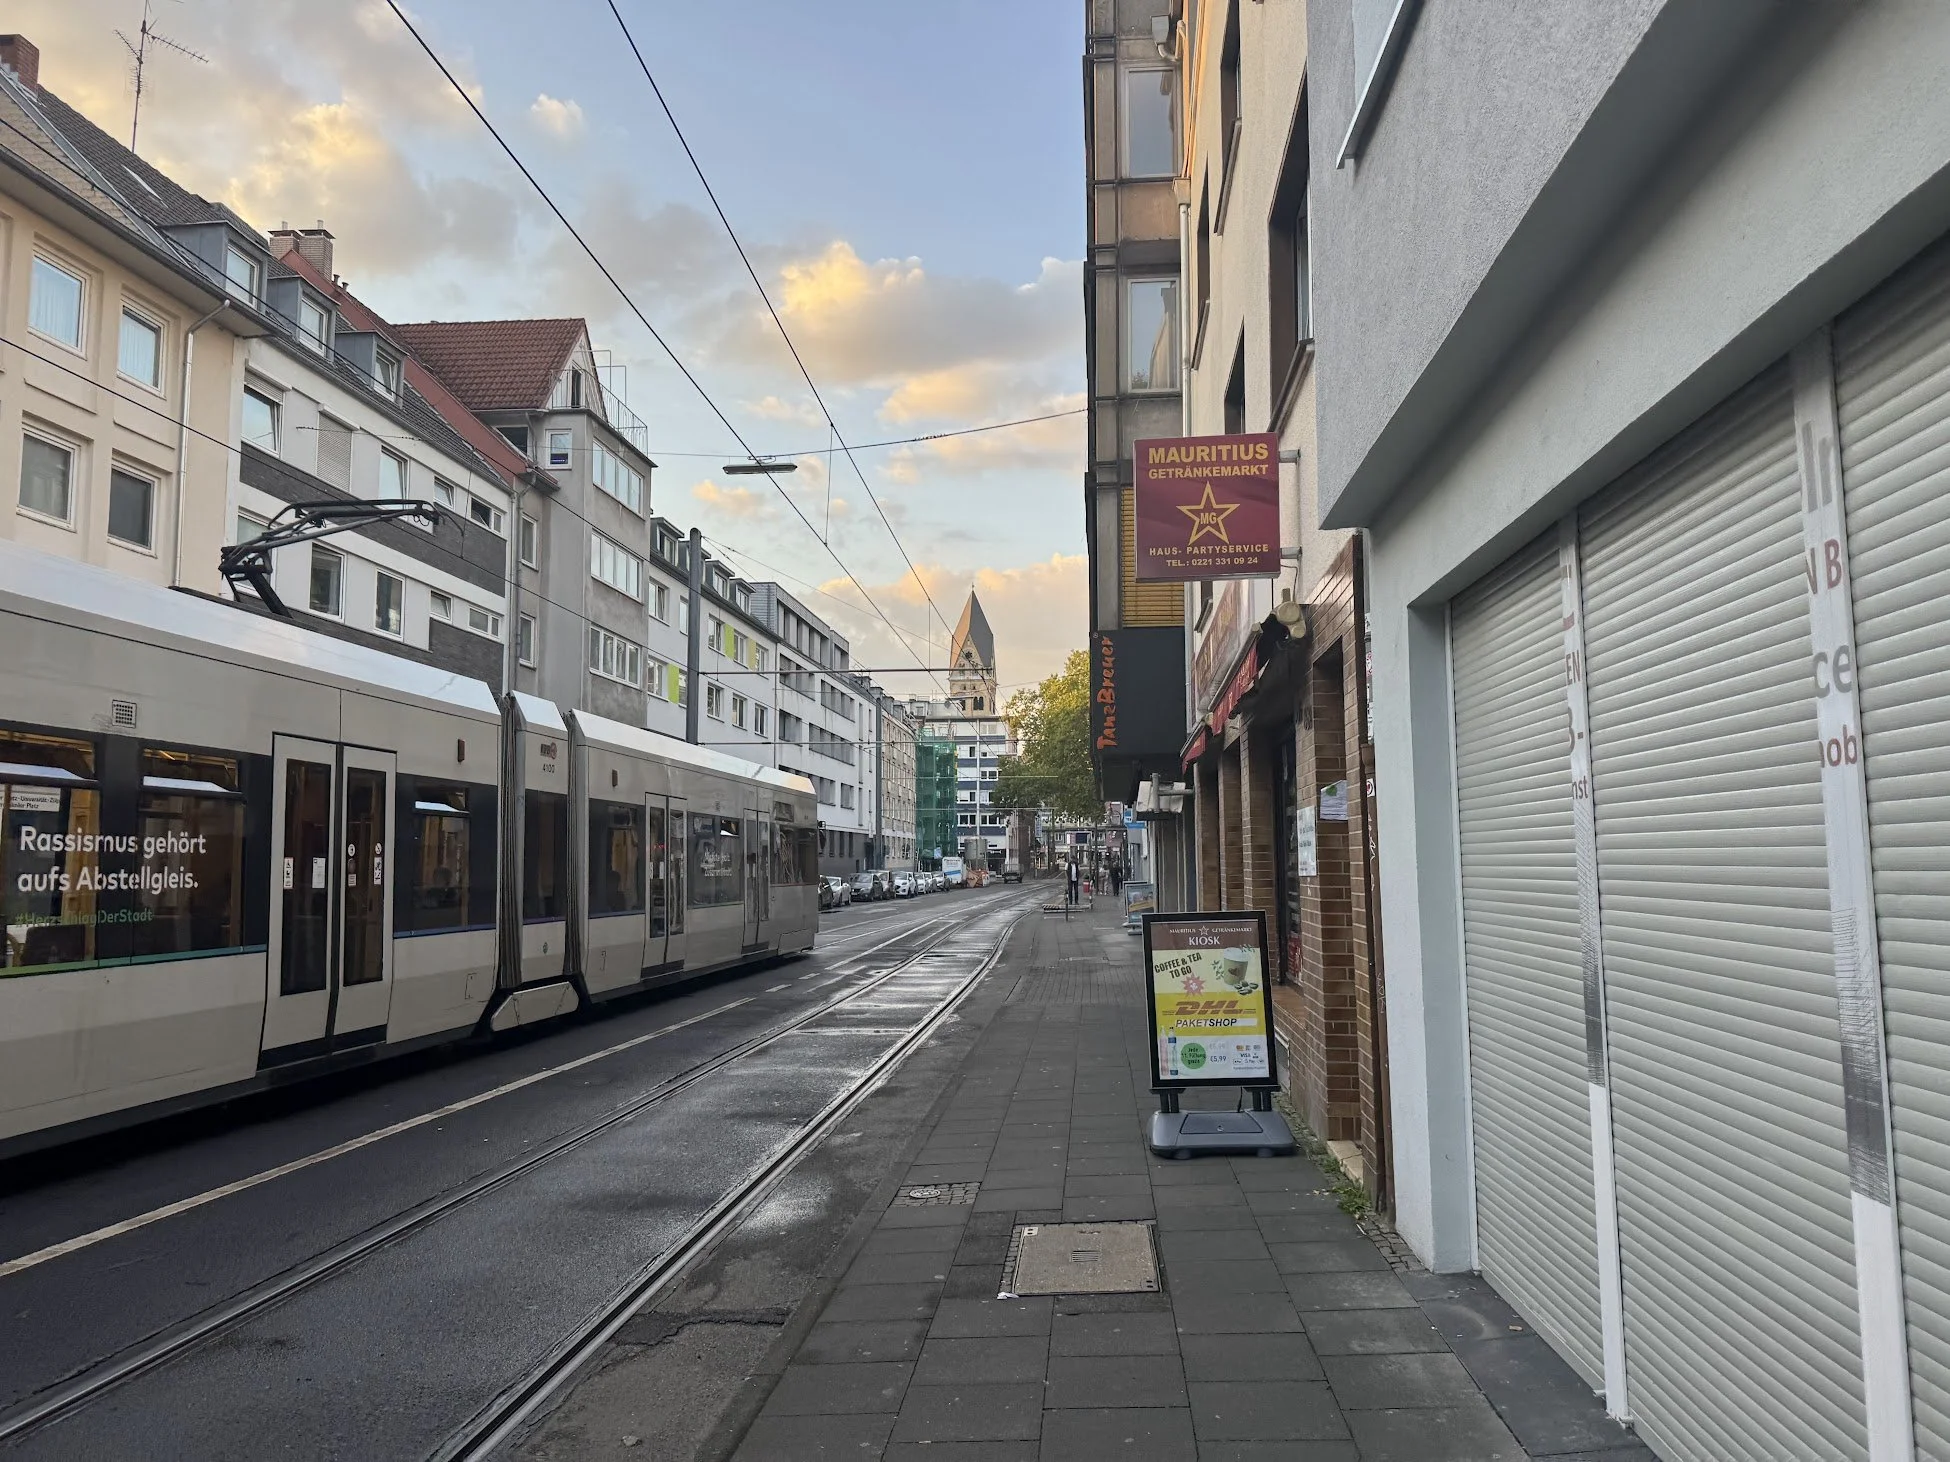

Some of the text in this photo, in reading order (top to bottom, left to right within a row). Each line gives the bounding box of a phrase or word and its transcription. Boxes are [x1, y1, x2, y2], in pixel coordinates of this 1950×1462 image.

[1149, 443, 1268, 464] MAURITIUS
[1149, 464, 1268, 479] GETRÄNKEMARKT
[1200, 512, 1217, 524] MG
[1149, 544, 1269, 556] HAUS- PARTYSERVICE
[1191, 558, 1213, 566] 0221
[1215, 557, 1231, 565] 331
[1234, 557, 1245, 565] 09
[20, 825, 207, 859] Rassismus gehört
[17, 866, 199, 896] aufs Abstellgleis.
[1188, 936, 1220, 946] KIOSK
[1154, 952, 1202, 973] COFFEE & TEA
[1169, 966, 1192, 979] TO GO
[1175, 1000, 1242, 1016] DHL
[1176, 1018, 1238, 1028] PAKETSHOP
